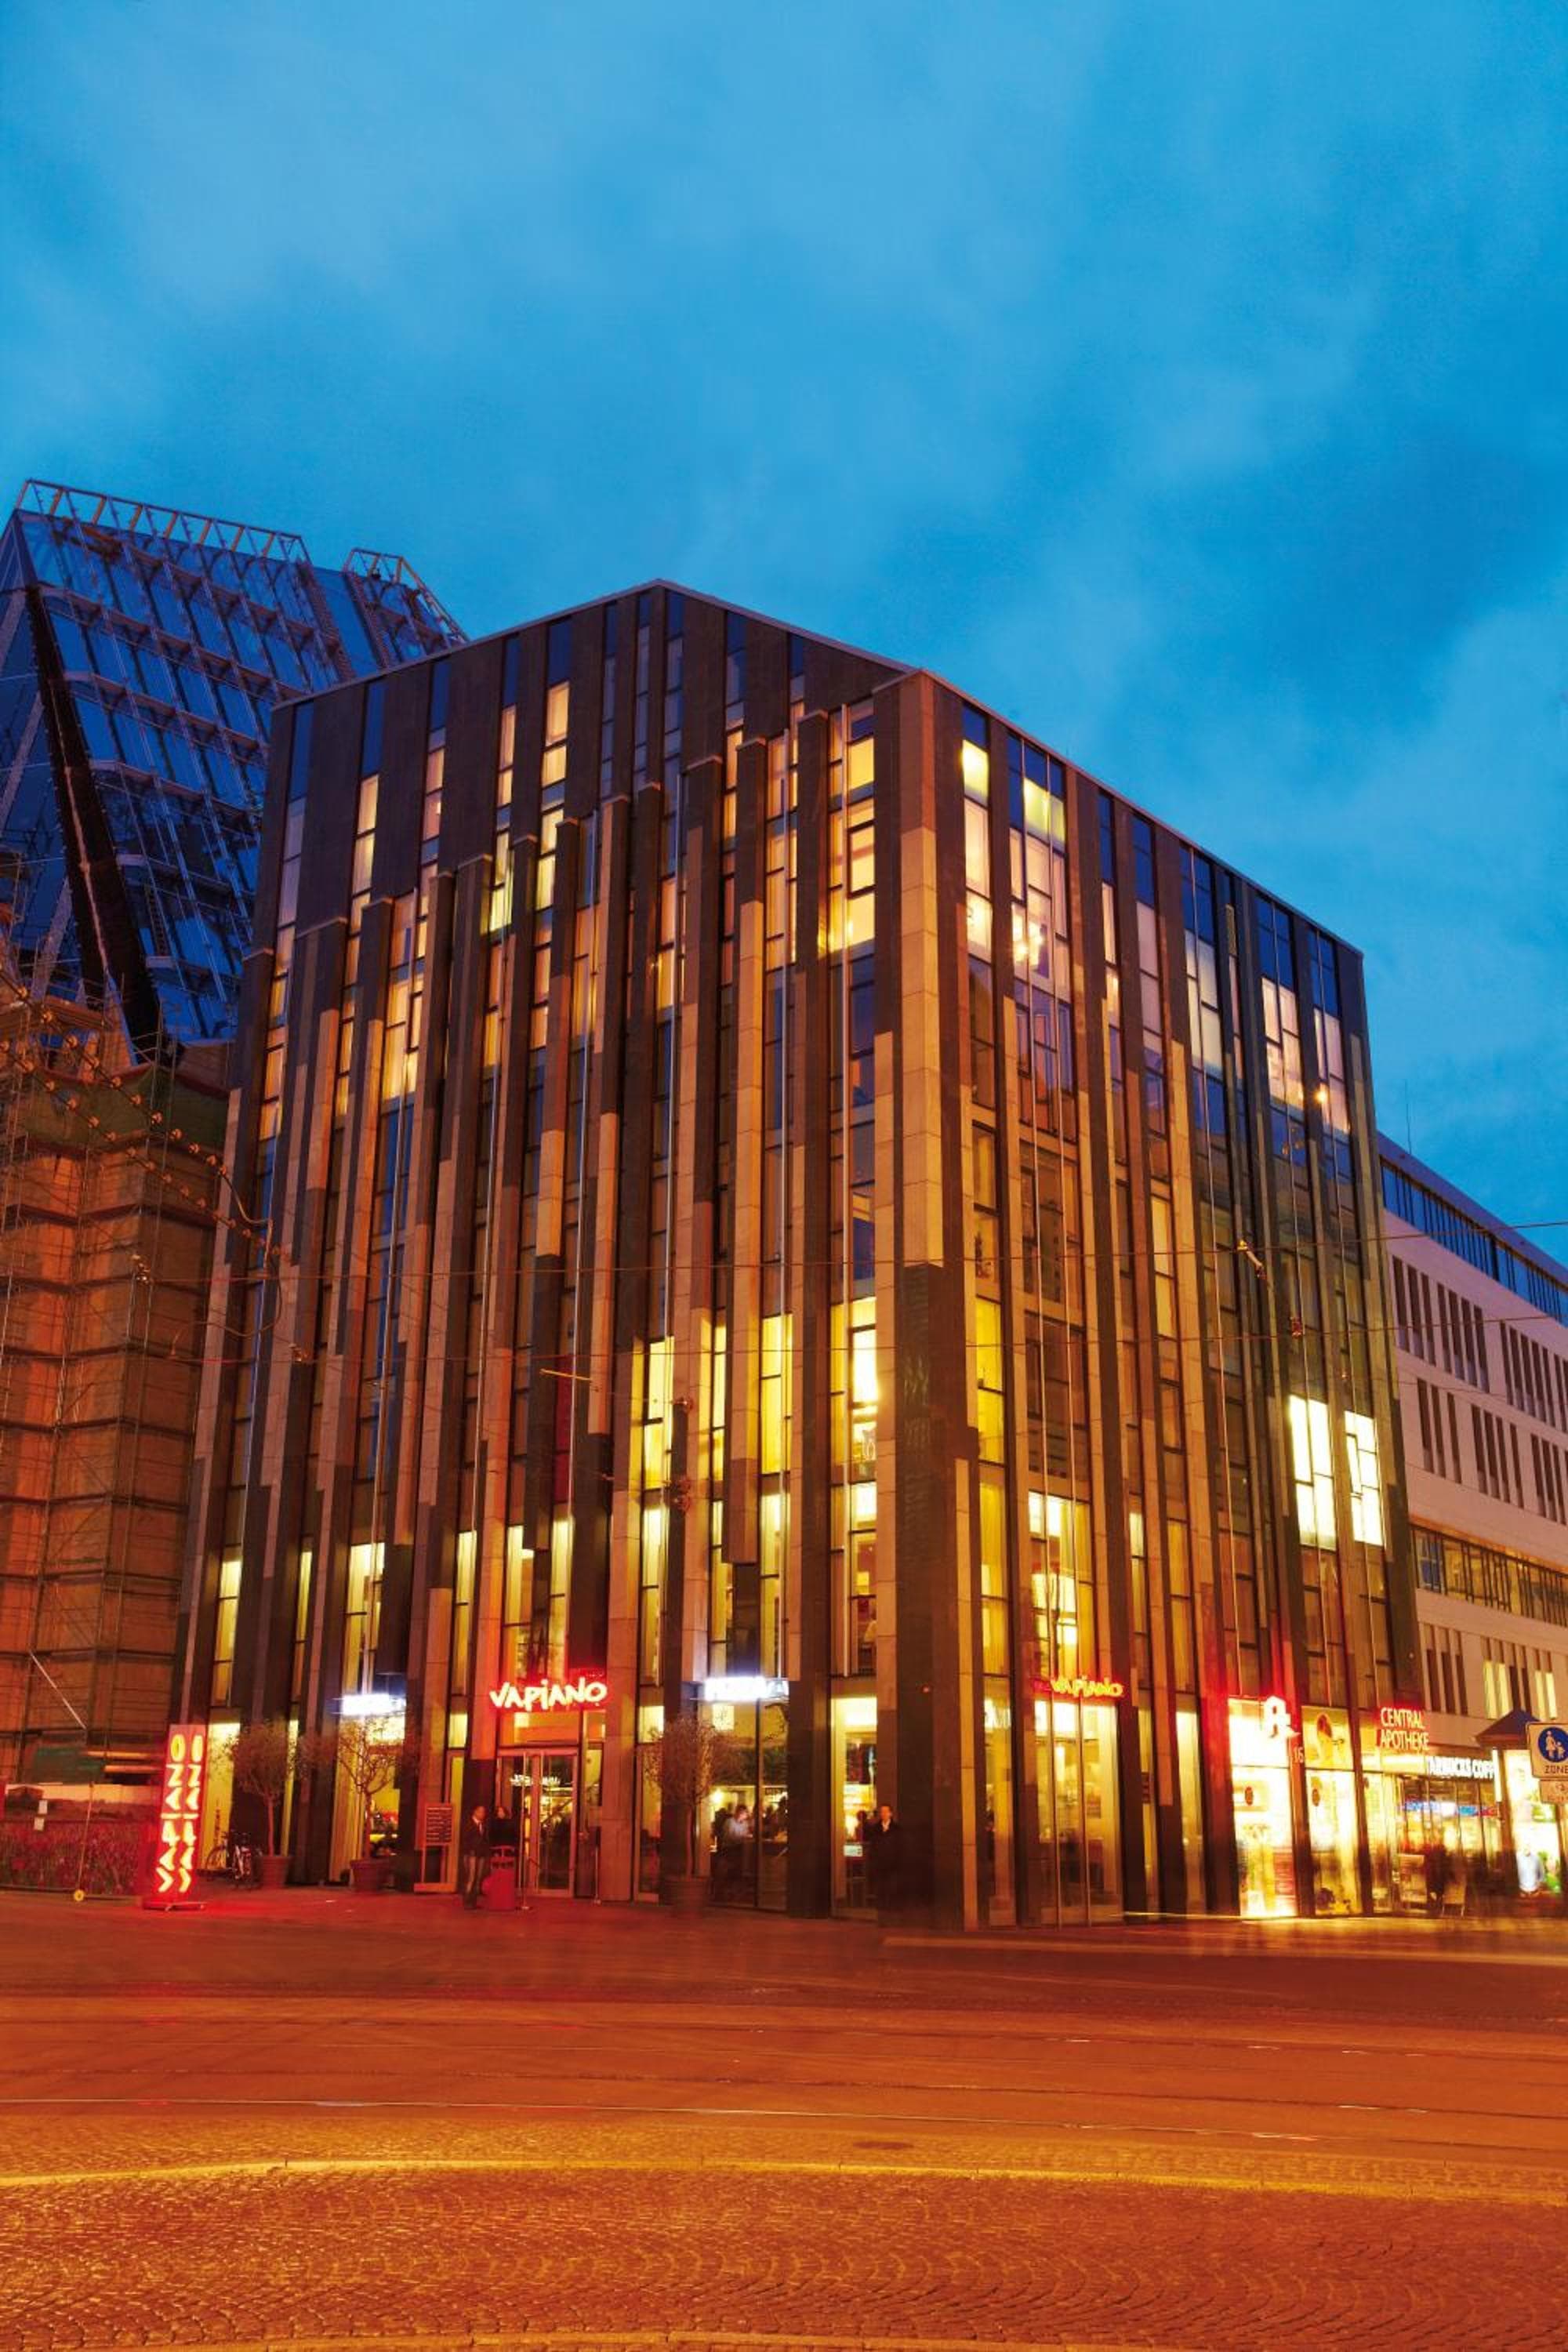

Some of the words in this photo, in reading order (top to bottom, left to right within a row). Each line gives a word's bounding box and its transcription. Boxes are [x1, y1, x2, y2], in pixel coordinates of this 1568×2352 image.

[1381, 1707, 1425, 1730] CENTRAL
[1381, 1729, 1430, 1751] APOTHEKE
[1544, 1765, 1568, 1774] ZONE
[155, 1733, 186, 1894] VAPIANO
[178, 1733, 204, 1893] VAPIANO
